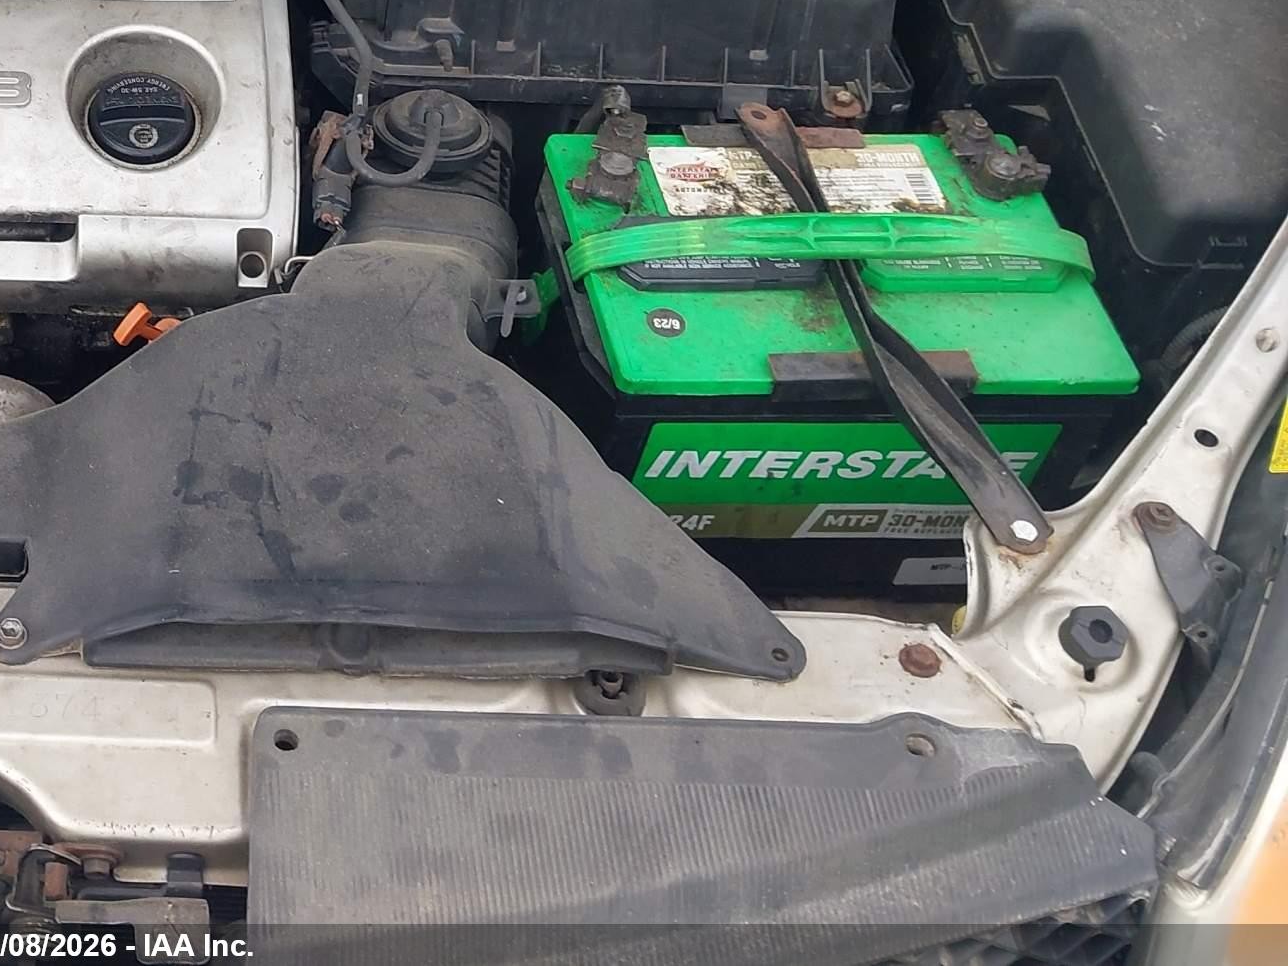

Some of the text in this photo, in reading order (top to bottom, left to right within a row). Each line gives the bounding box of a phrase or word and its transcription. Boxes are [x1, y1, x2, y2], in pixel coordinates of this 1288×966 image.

[856, 152, 920, 164] 30-MONTH
[652, 317, 681, 331] 6/23
[644, 450, 1038, 480] INTERSTAE
[822, 514, 970, 529] MTP 30-MON
